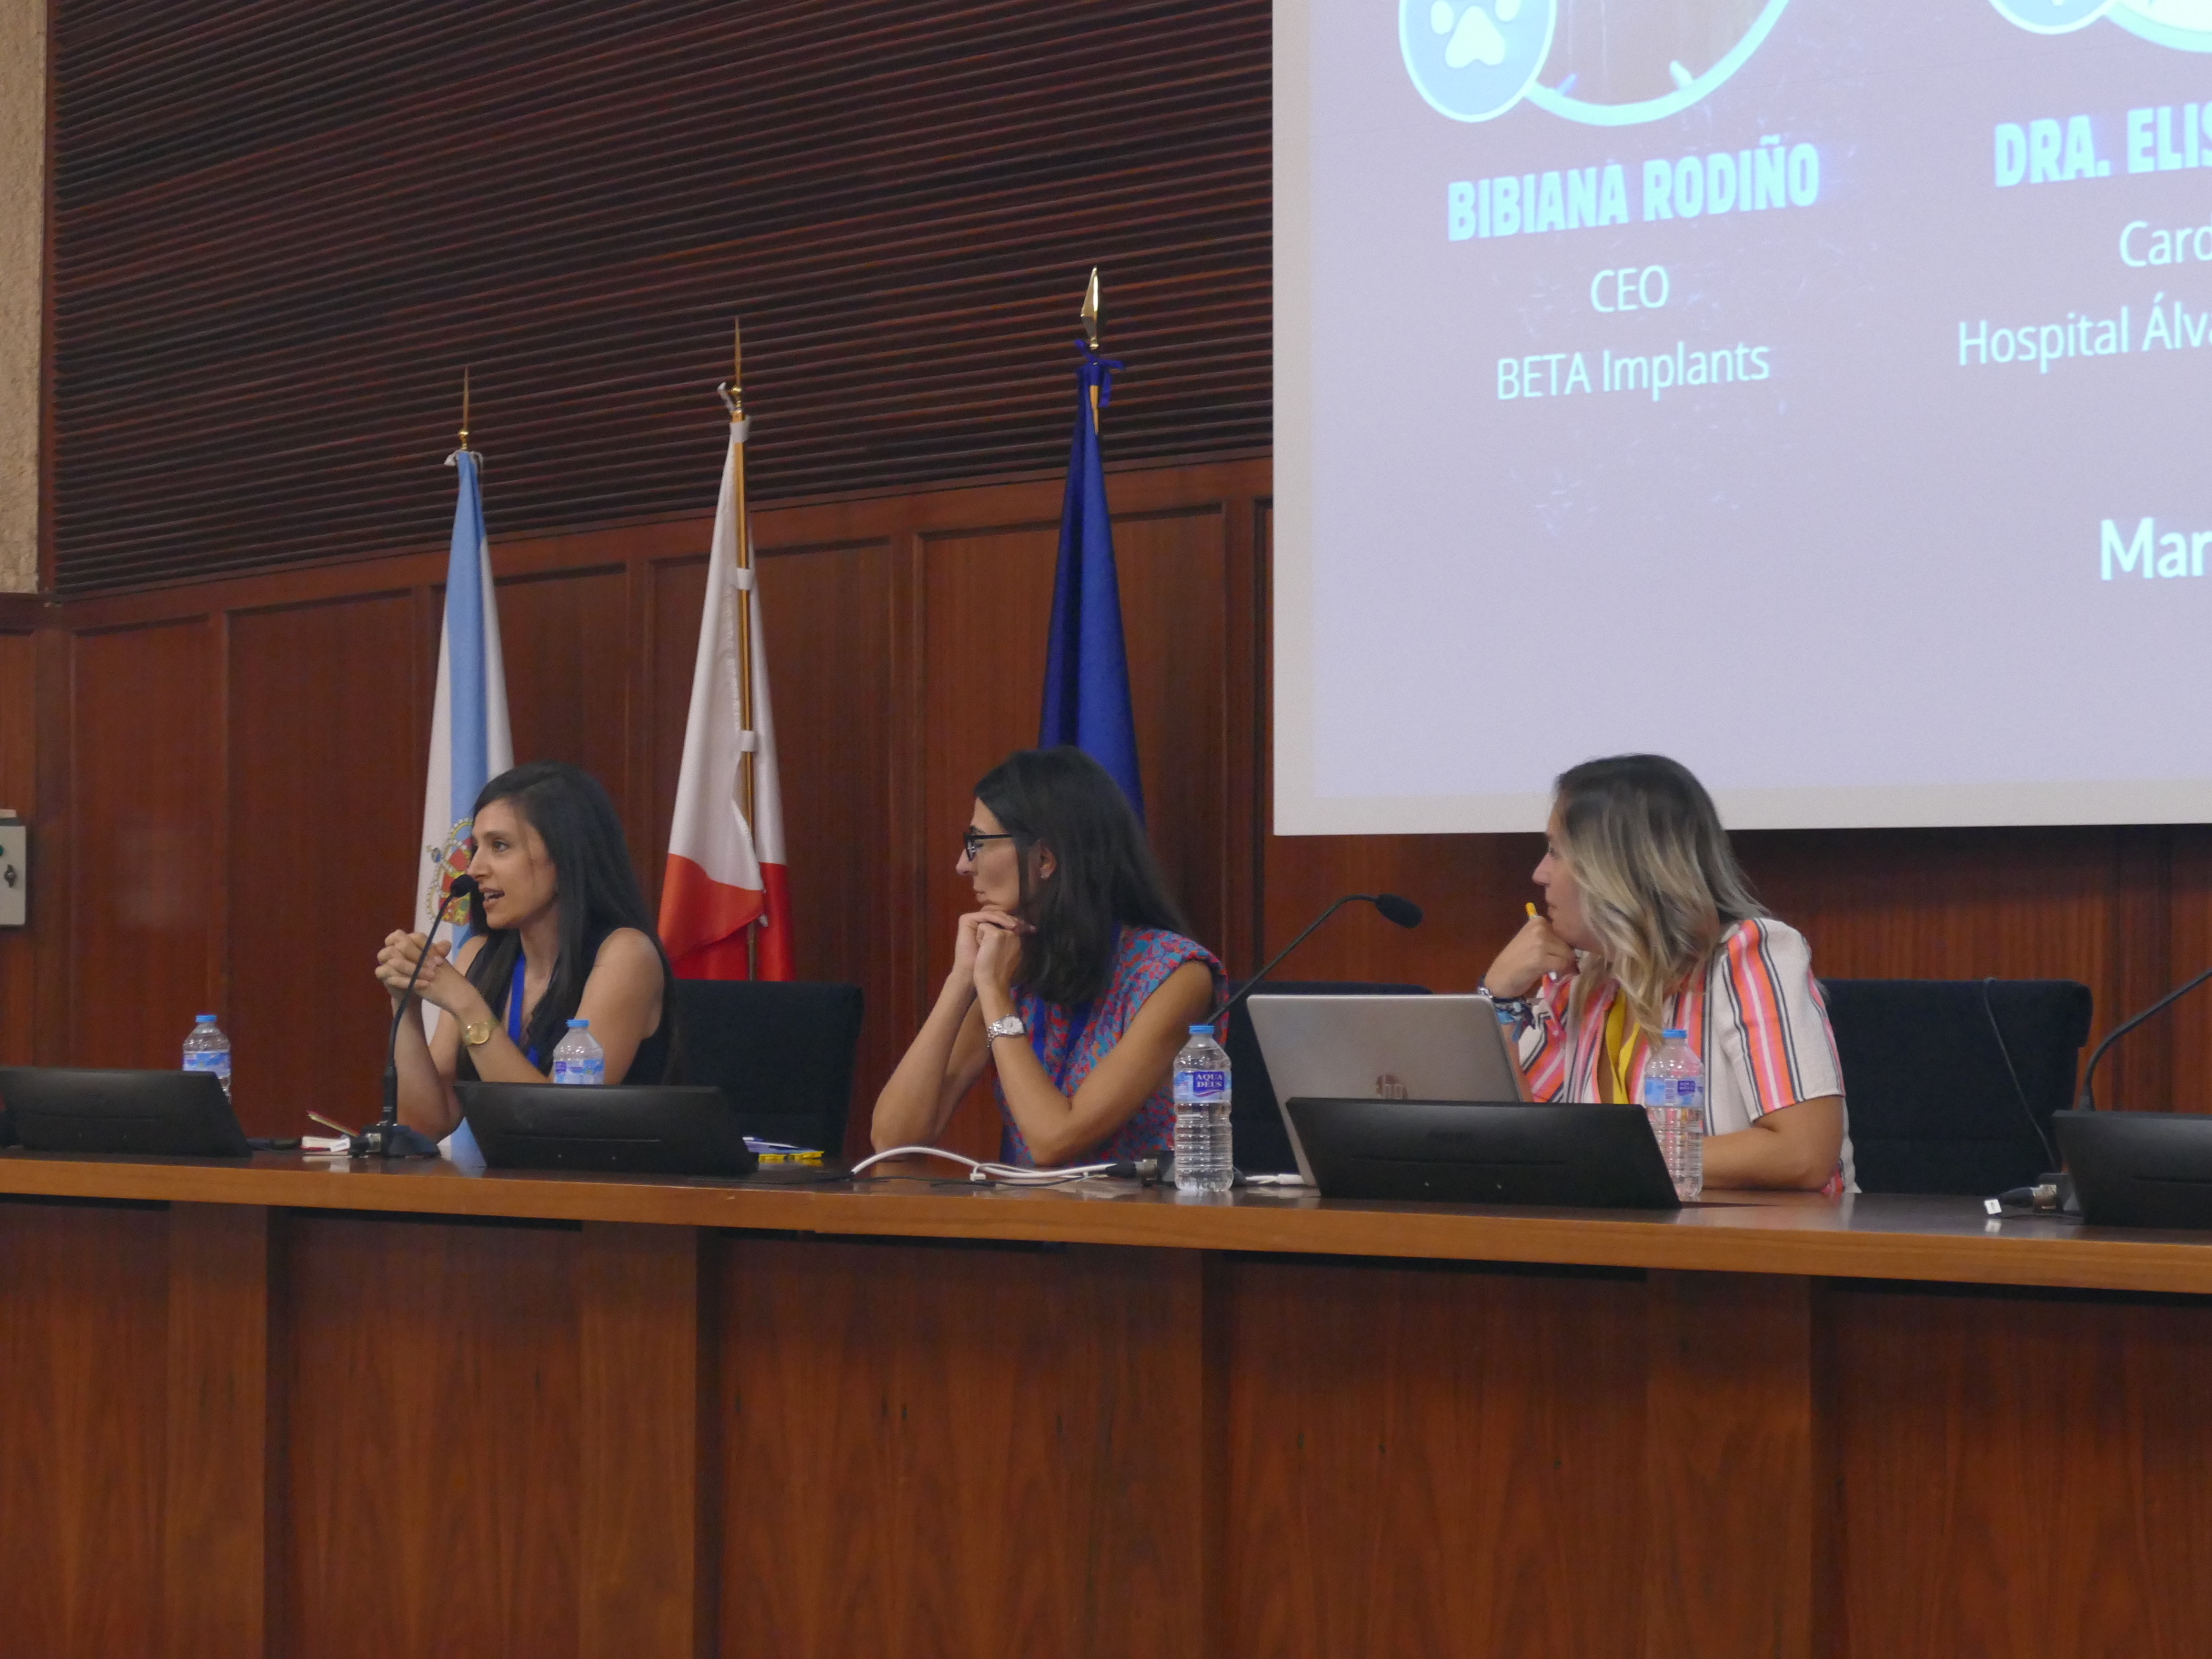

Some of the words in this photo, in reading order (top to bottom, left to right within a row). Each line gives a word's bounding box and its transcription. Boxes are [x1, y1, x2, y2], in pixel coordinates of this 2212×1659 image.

[1995, 114, 2111, 187] DRA.
[1448, 163, 1630, 242] BIBIANA
[1643, 134, 1820, 222] RODIÑO
[1590, 265, 1670, 313] CEO
[1958, 304, 2130, 375] Hospital
[2141, 290, 2212, 353] Álv
[1497, 351, 1593, 400] BETA
[1603, 340, 1771, 402] Implants
[2101, 516, 2212, 581] Mar
[1196, 1073, 1223, 1081] AQUA
